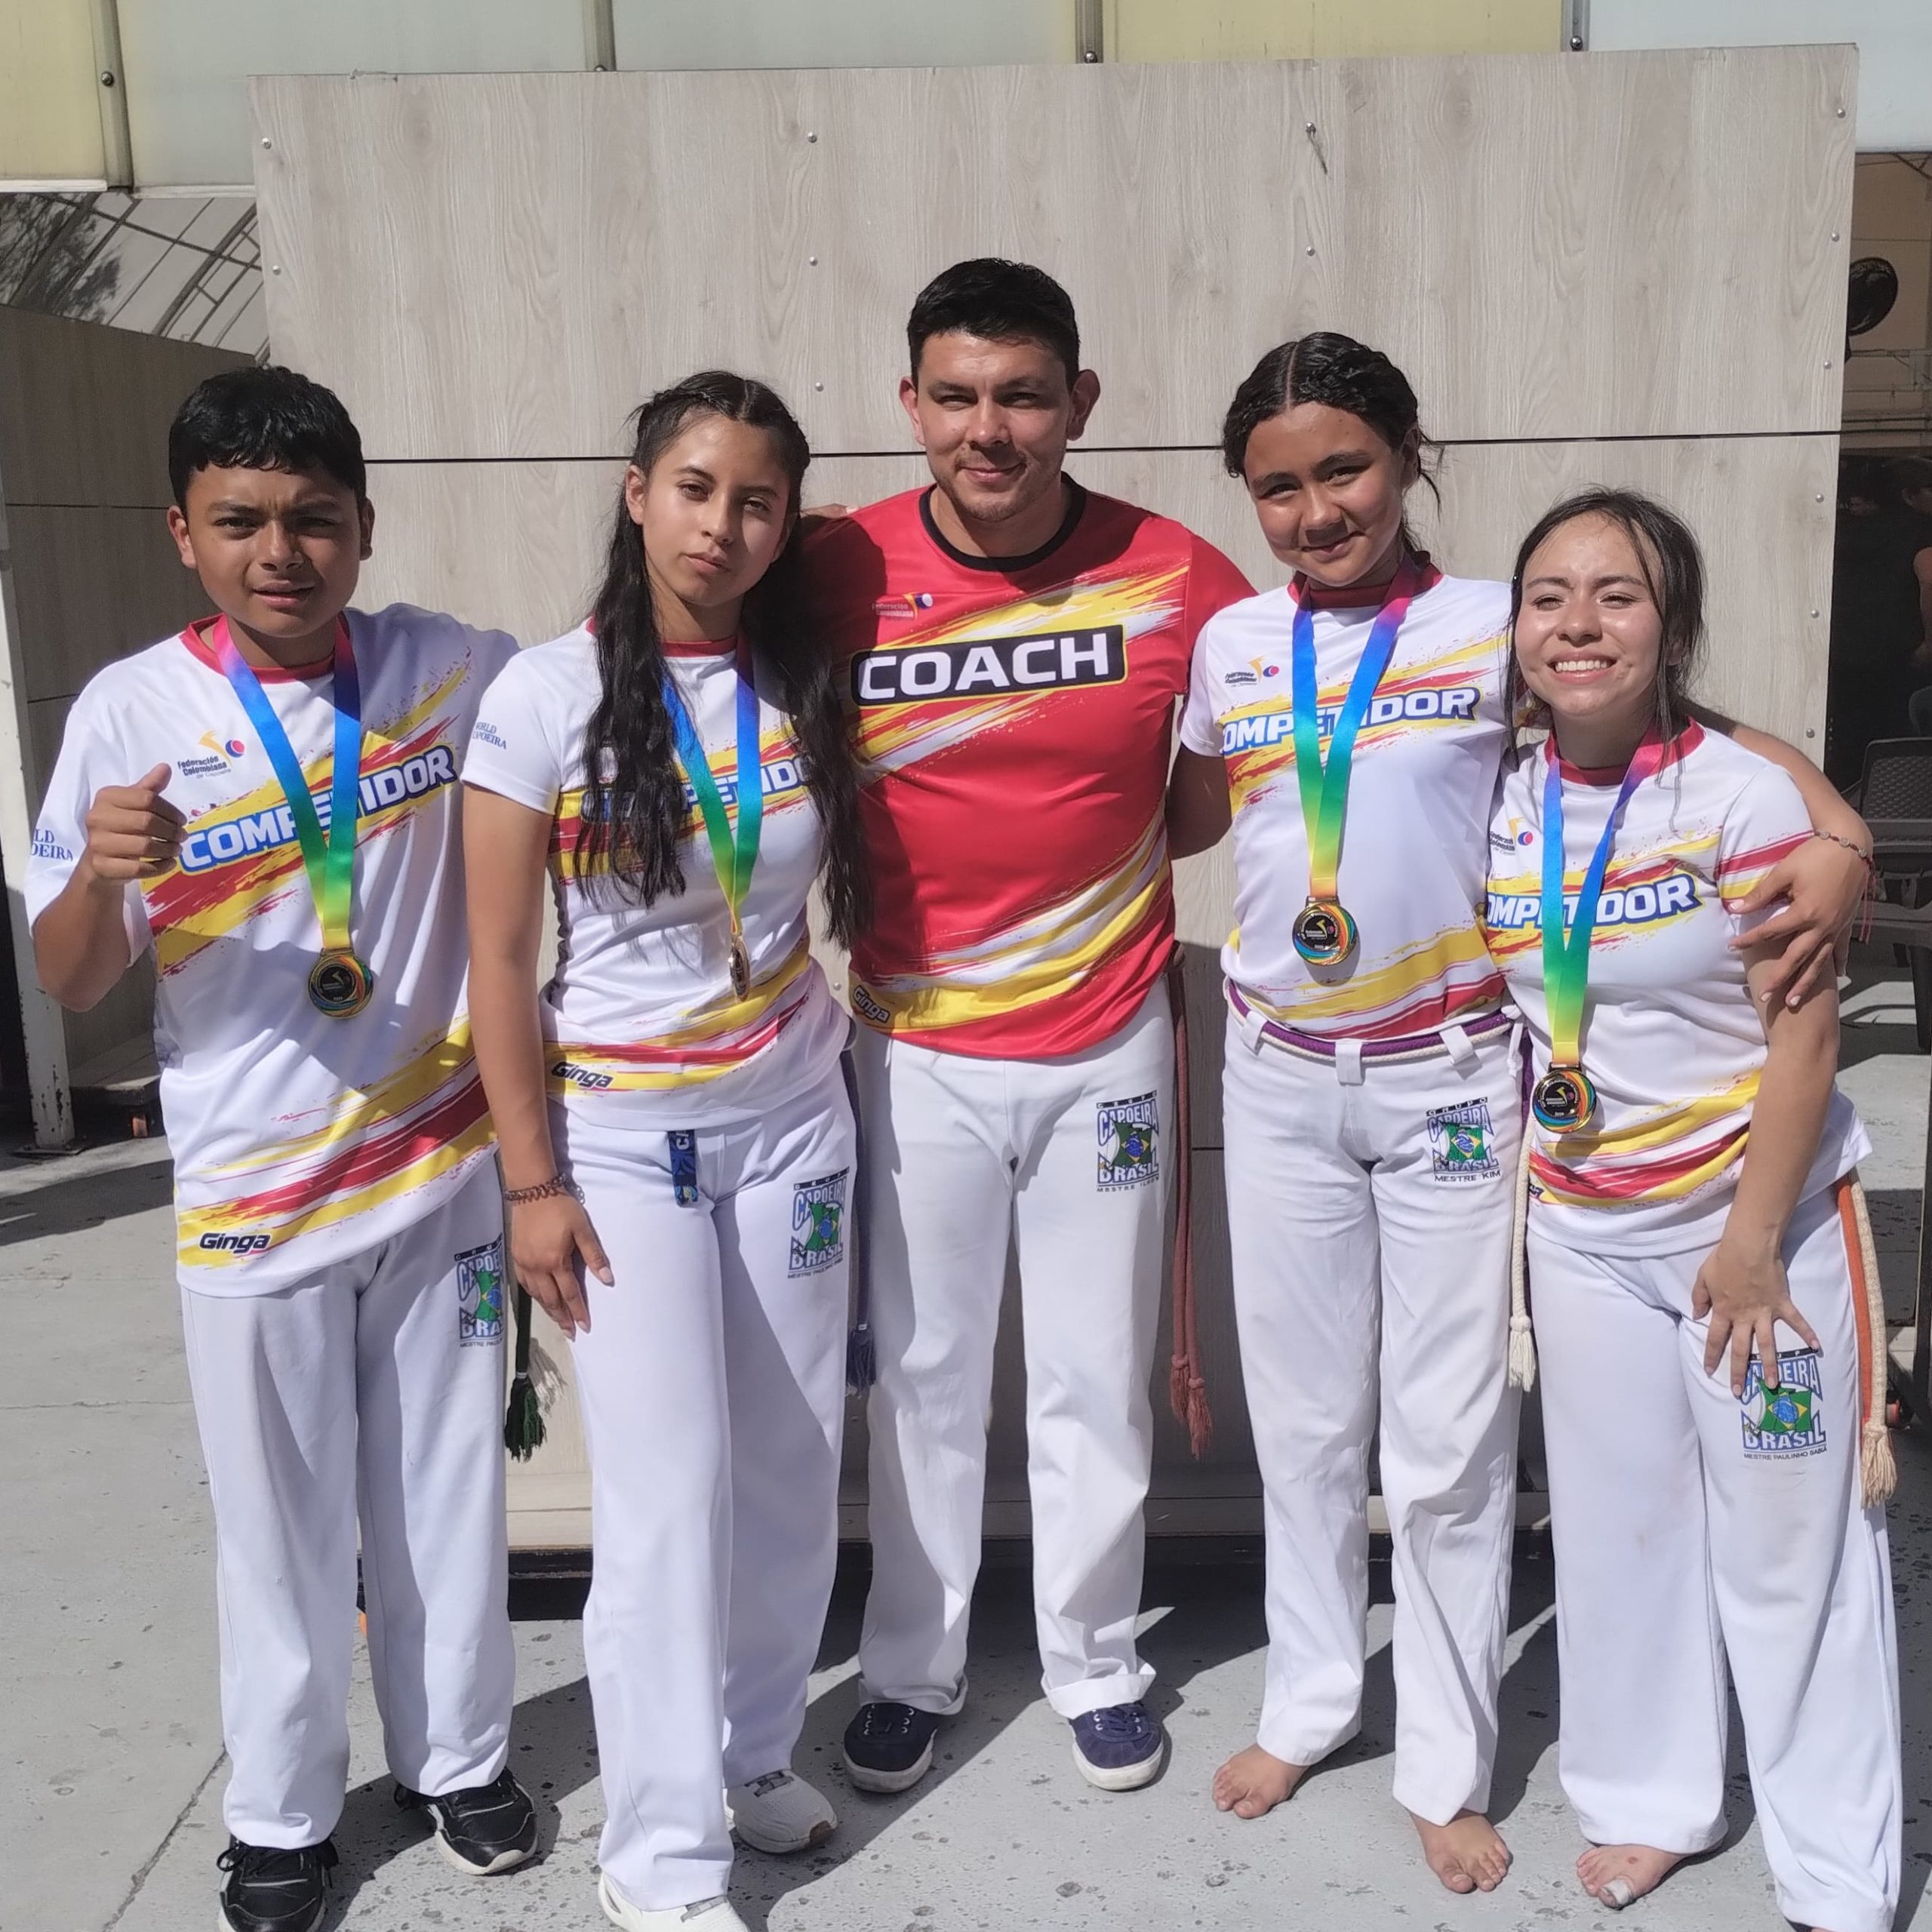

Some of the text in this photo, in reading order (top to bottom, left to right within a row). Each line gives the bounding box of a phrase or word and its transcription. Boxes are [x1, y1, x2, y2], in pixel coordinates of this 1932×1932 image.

[858, 632, 1109, 700] COACH
[853, 984, 891, 1023] Ginga
[551, 1061, 614, 1088] Ginga
[1482, 1170, 1500, 1179] KIM
[199, 1232, 271, 1254] Ginga
[1741, 1410, 1826, 1451] BRASIL
[1774, 1451, 1808, 1460] PAULINHO
